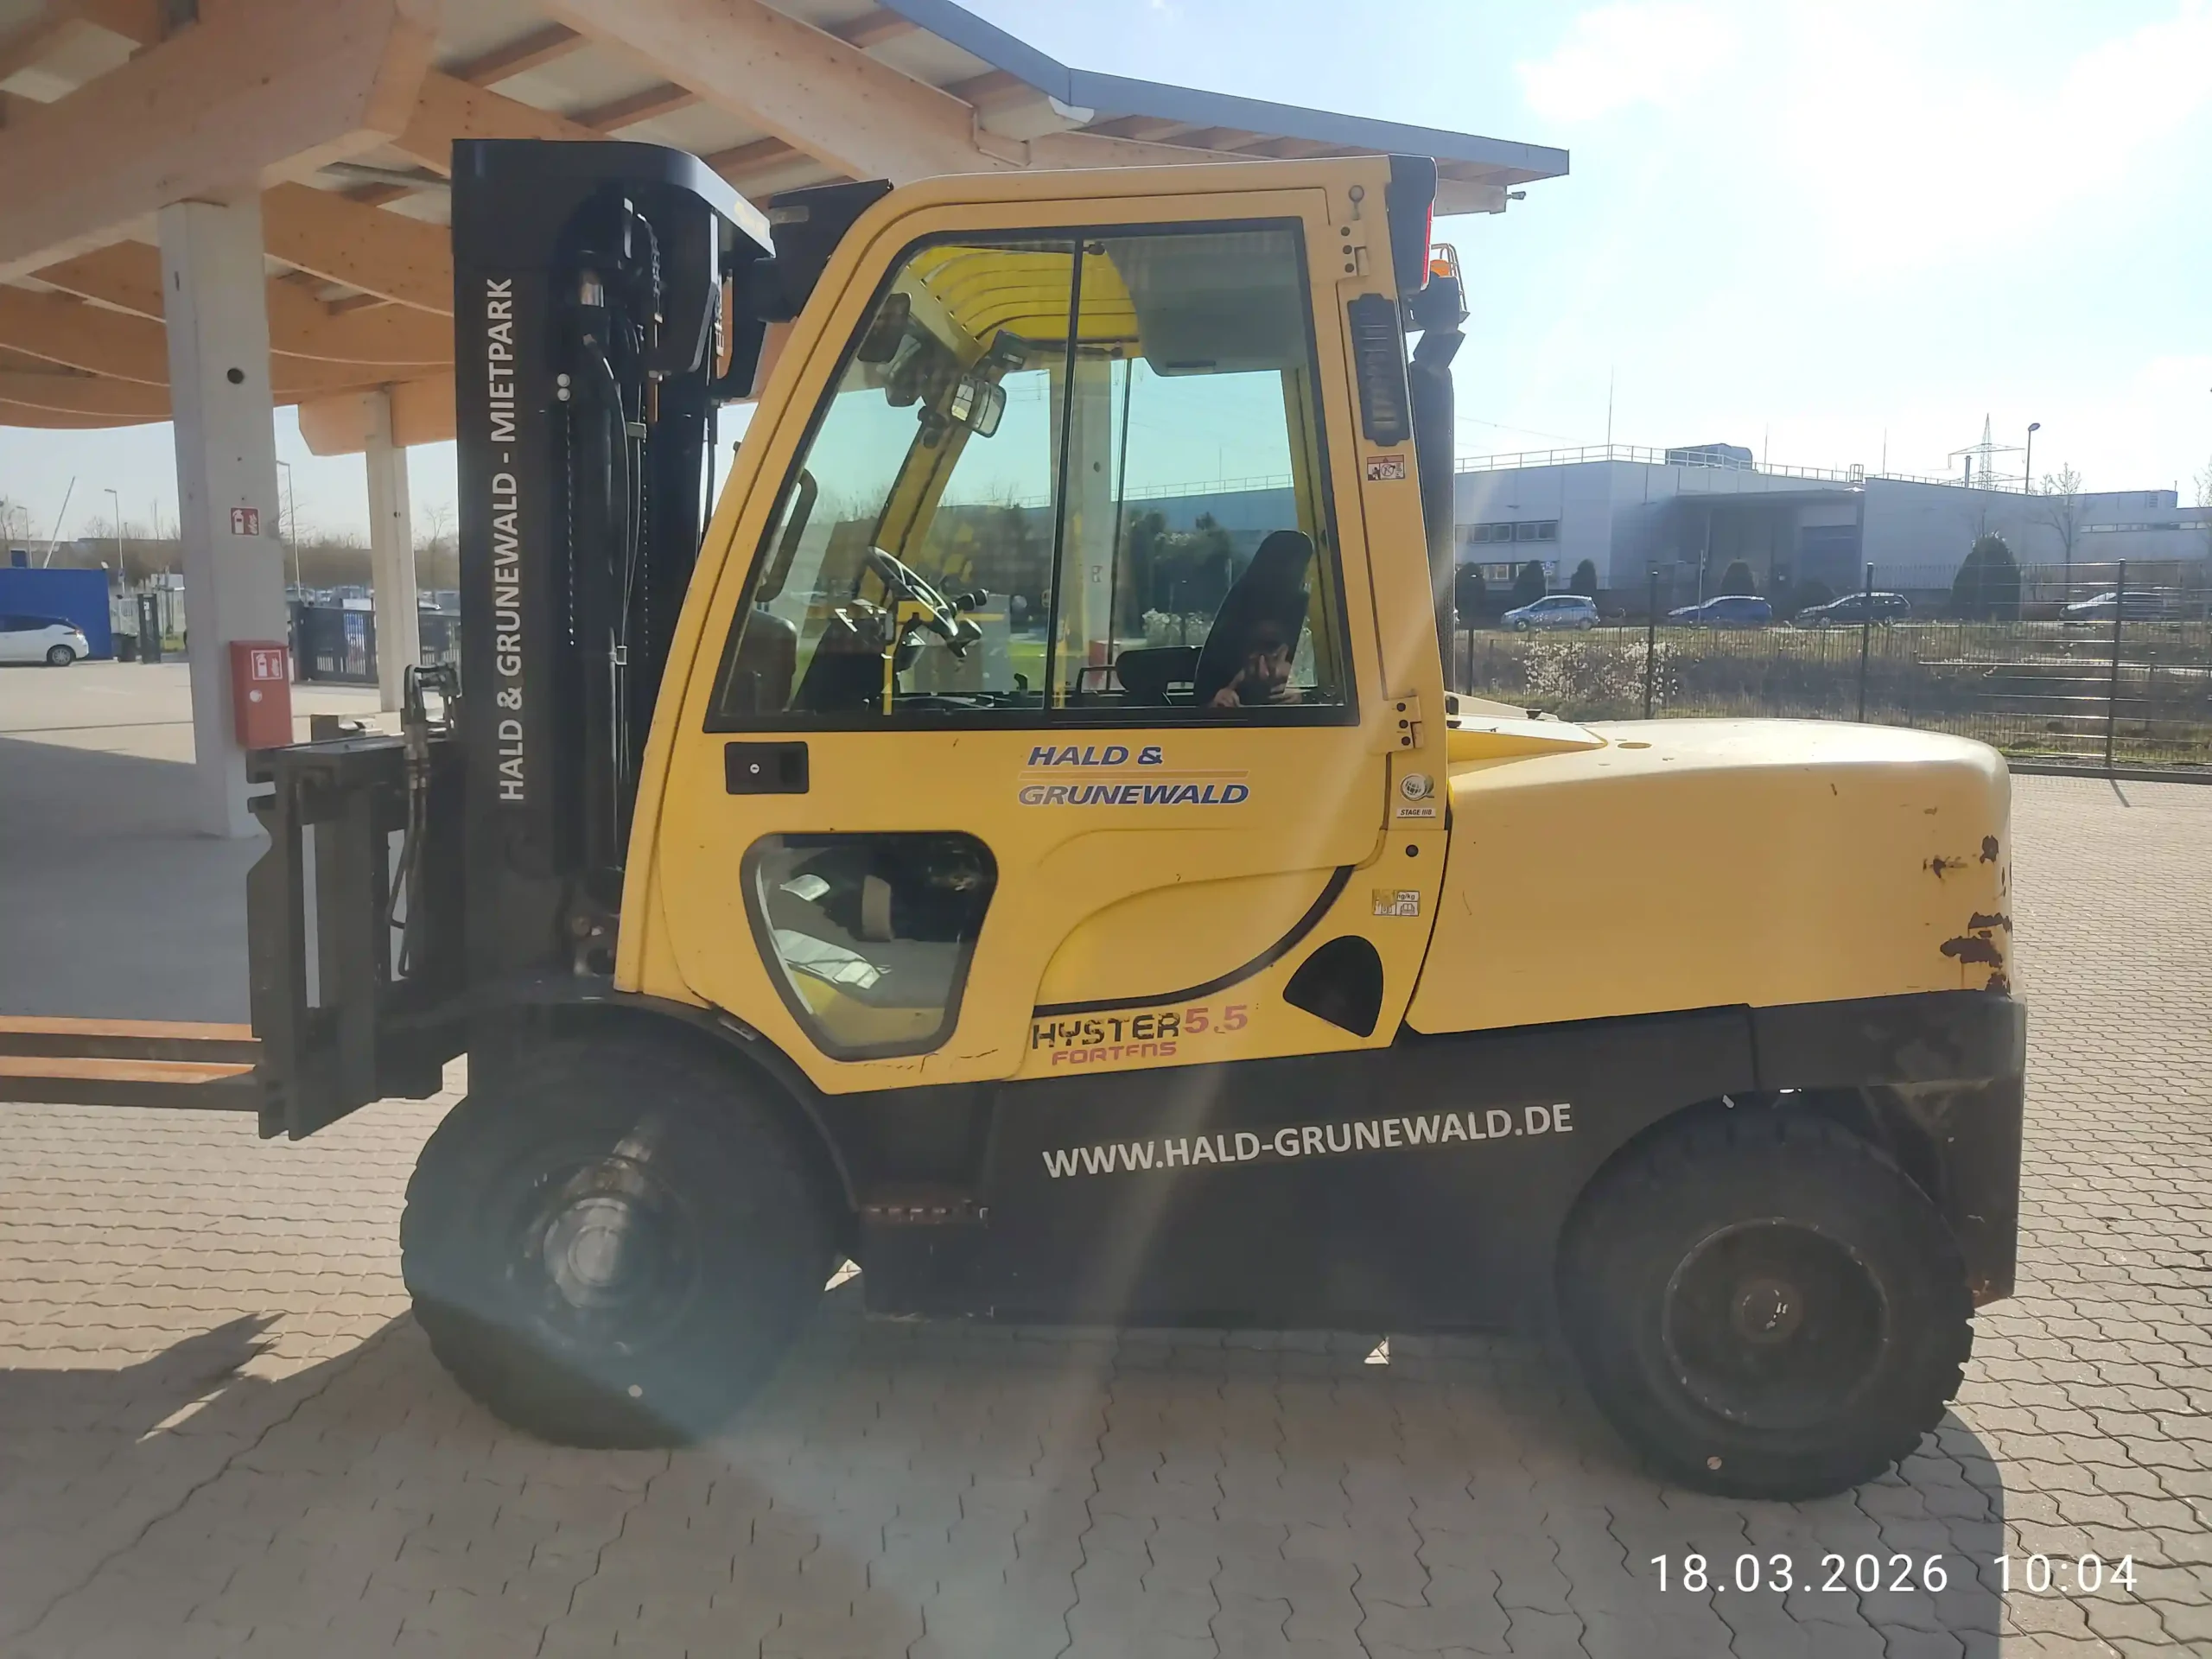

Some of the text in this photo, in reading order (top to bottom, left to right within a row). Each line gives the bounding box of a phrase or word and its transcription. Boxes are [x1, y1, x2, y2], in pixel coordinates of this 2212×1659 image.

[486, 277, 517, 443] MIETPARK
[491, 472, 522, 677] GRUNEWALD
[496, 686, 523, 710] &
[498, 719, 525, 801] HALD
[1027, 746, 1164, 766] HALD &
[1018, 784, 1249, 804] GRUNEWALD
[1033, 1012, 1181, 1049] HYSTER
[1041, 1103, 1573, 1179] WWW.HALD-GRUNEWALD.DE
